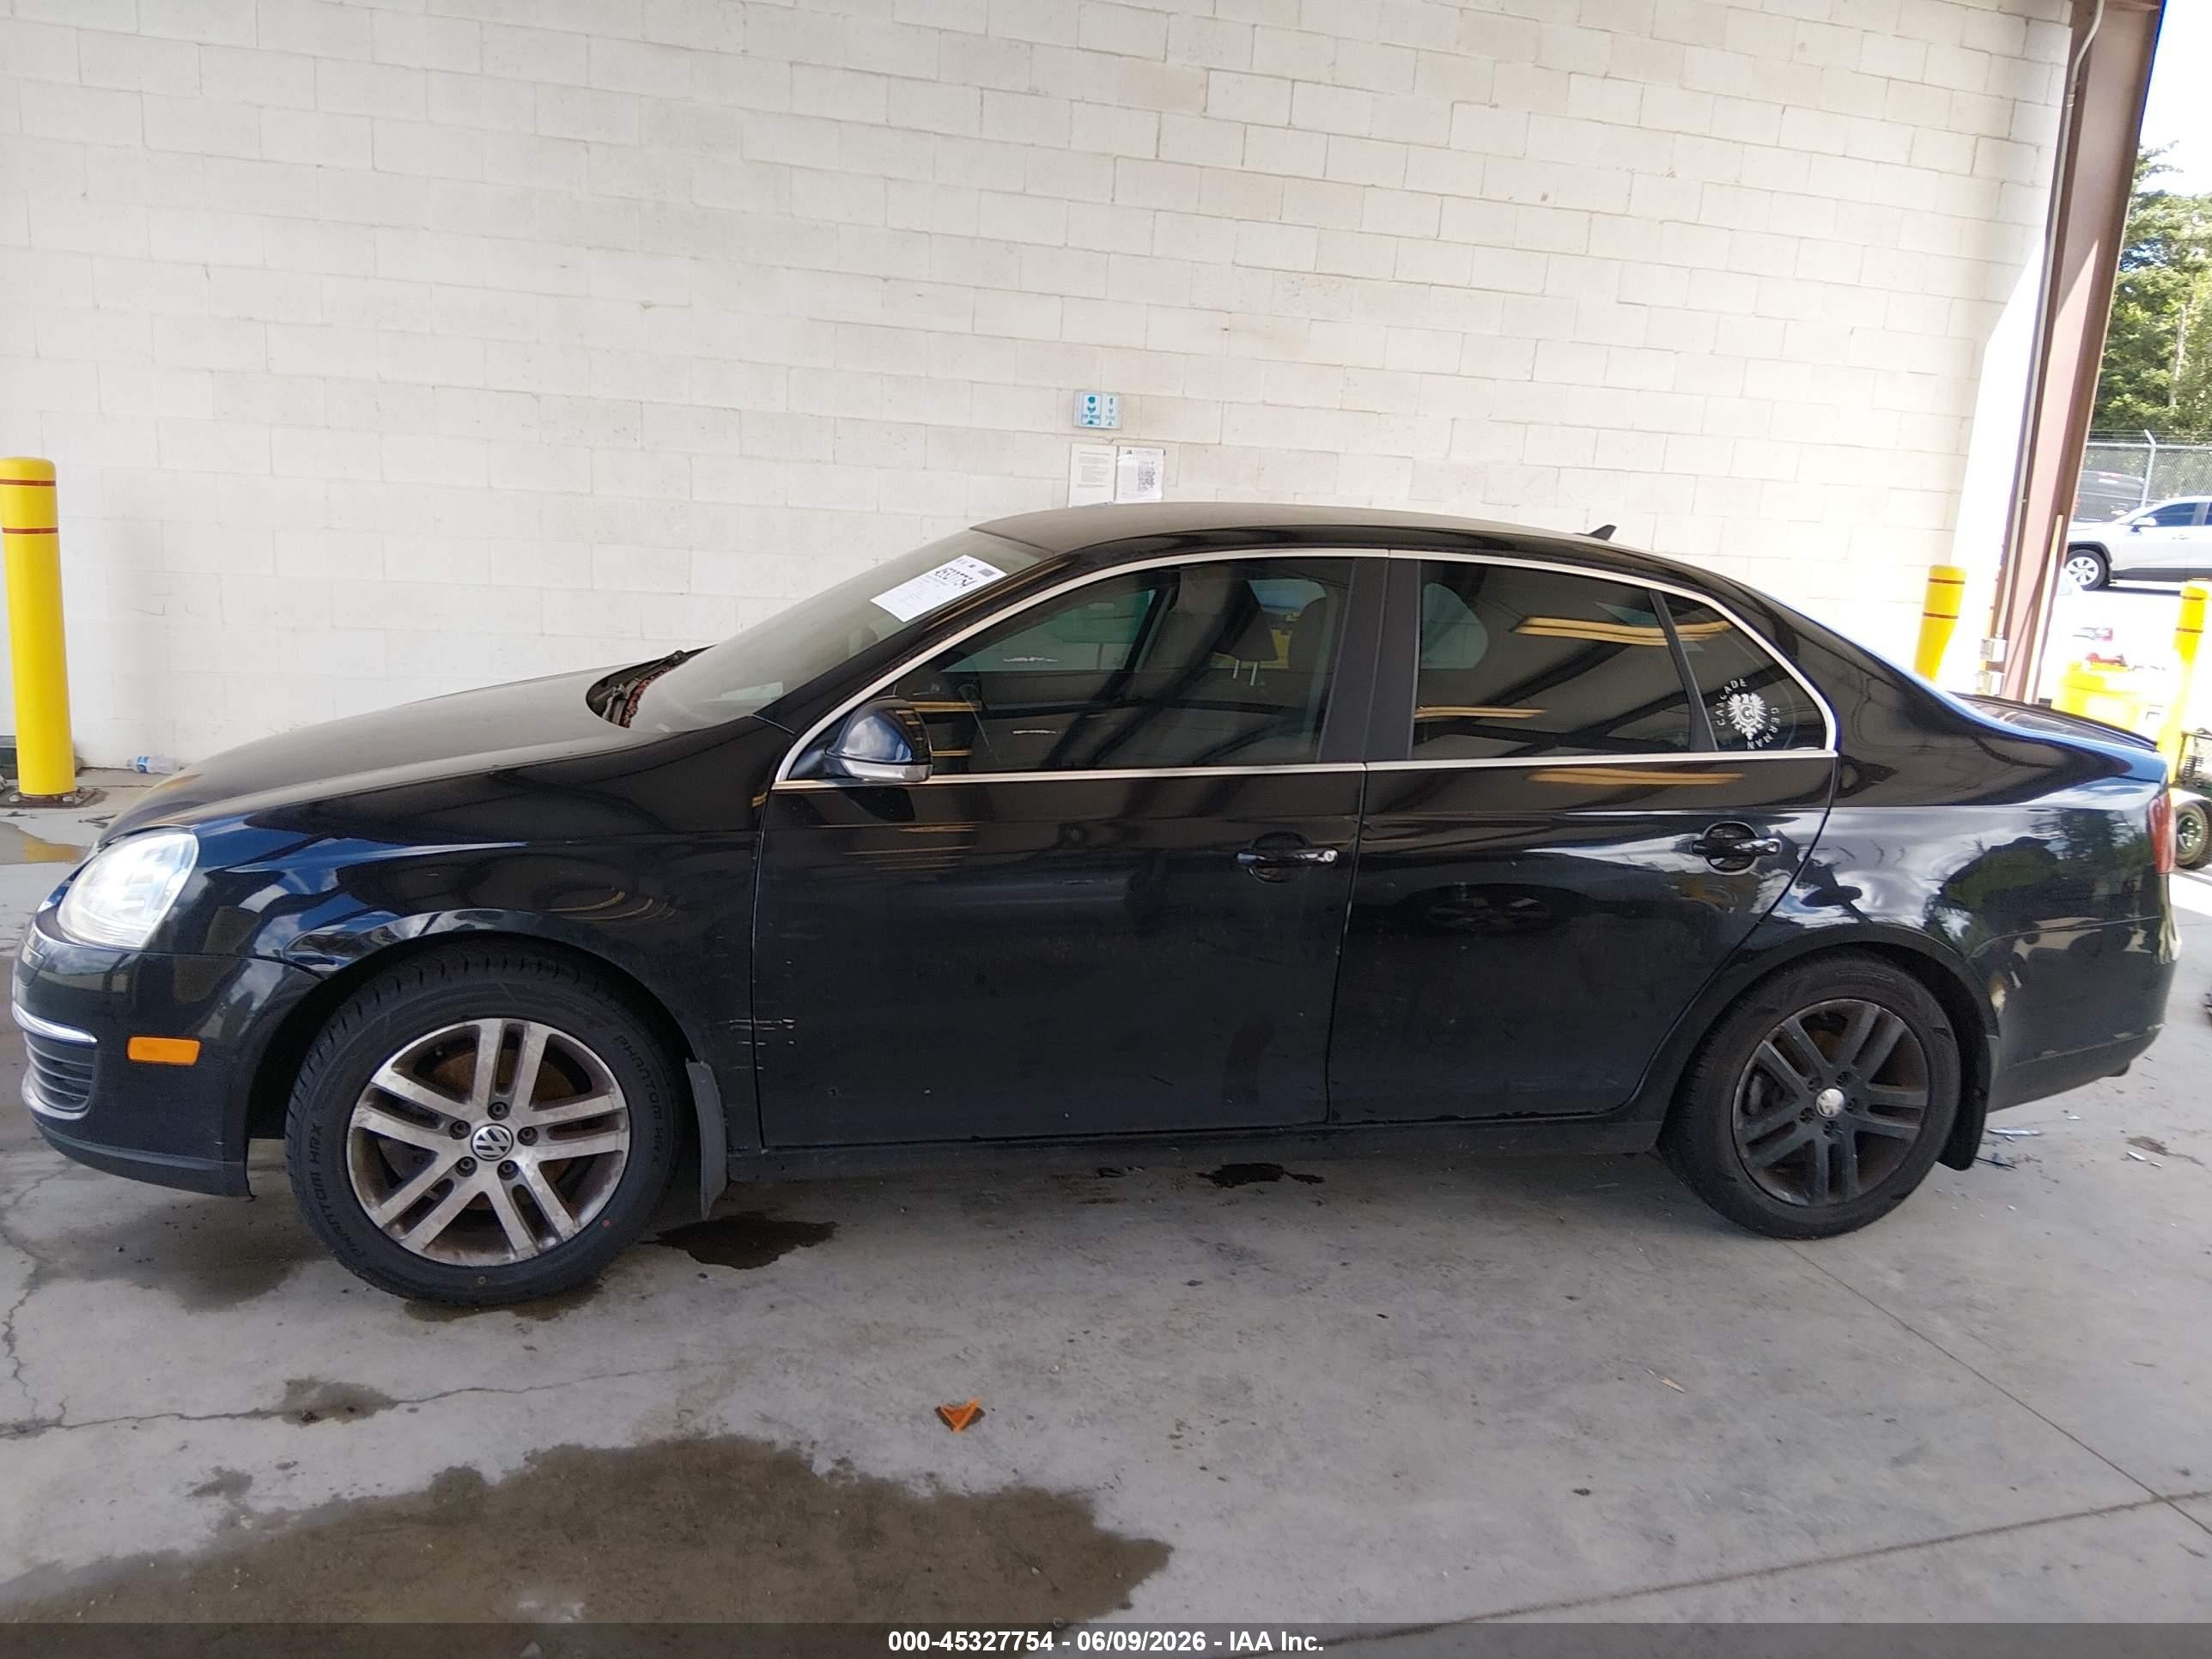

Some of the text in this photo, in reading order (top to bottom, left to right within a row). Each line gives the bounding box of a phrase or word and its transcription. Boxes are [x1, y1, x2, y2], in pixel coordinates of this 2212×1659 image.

[1715, 678, 1780, 749] CASCADE GERMAN
[613, 1034, 663, 1120] PHANTOM
[309, 1123, 323, 1164] HRX
